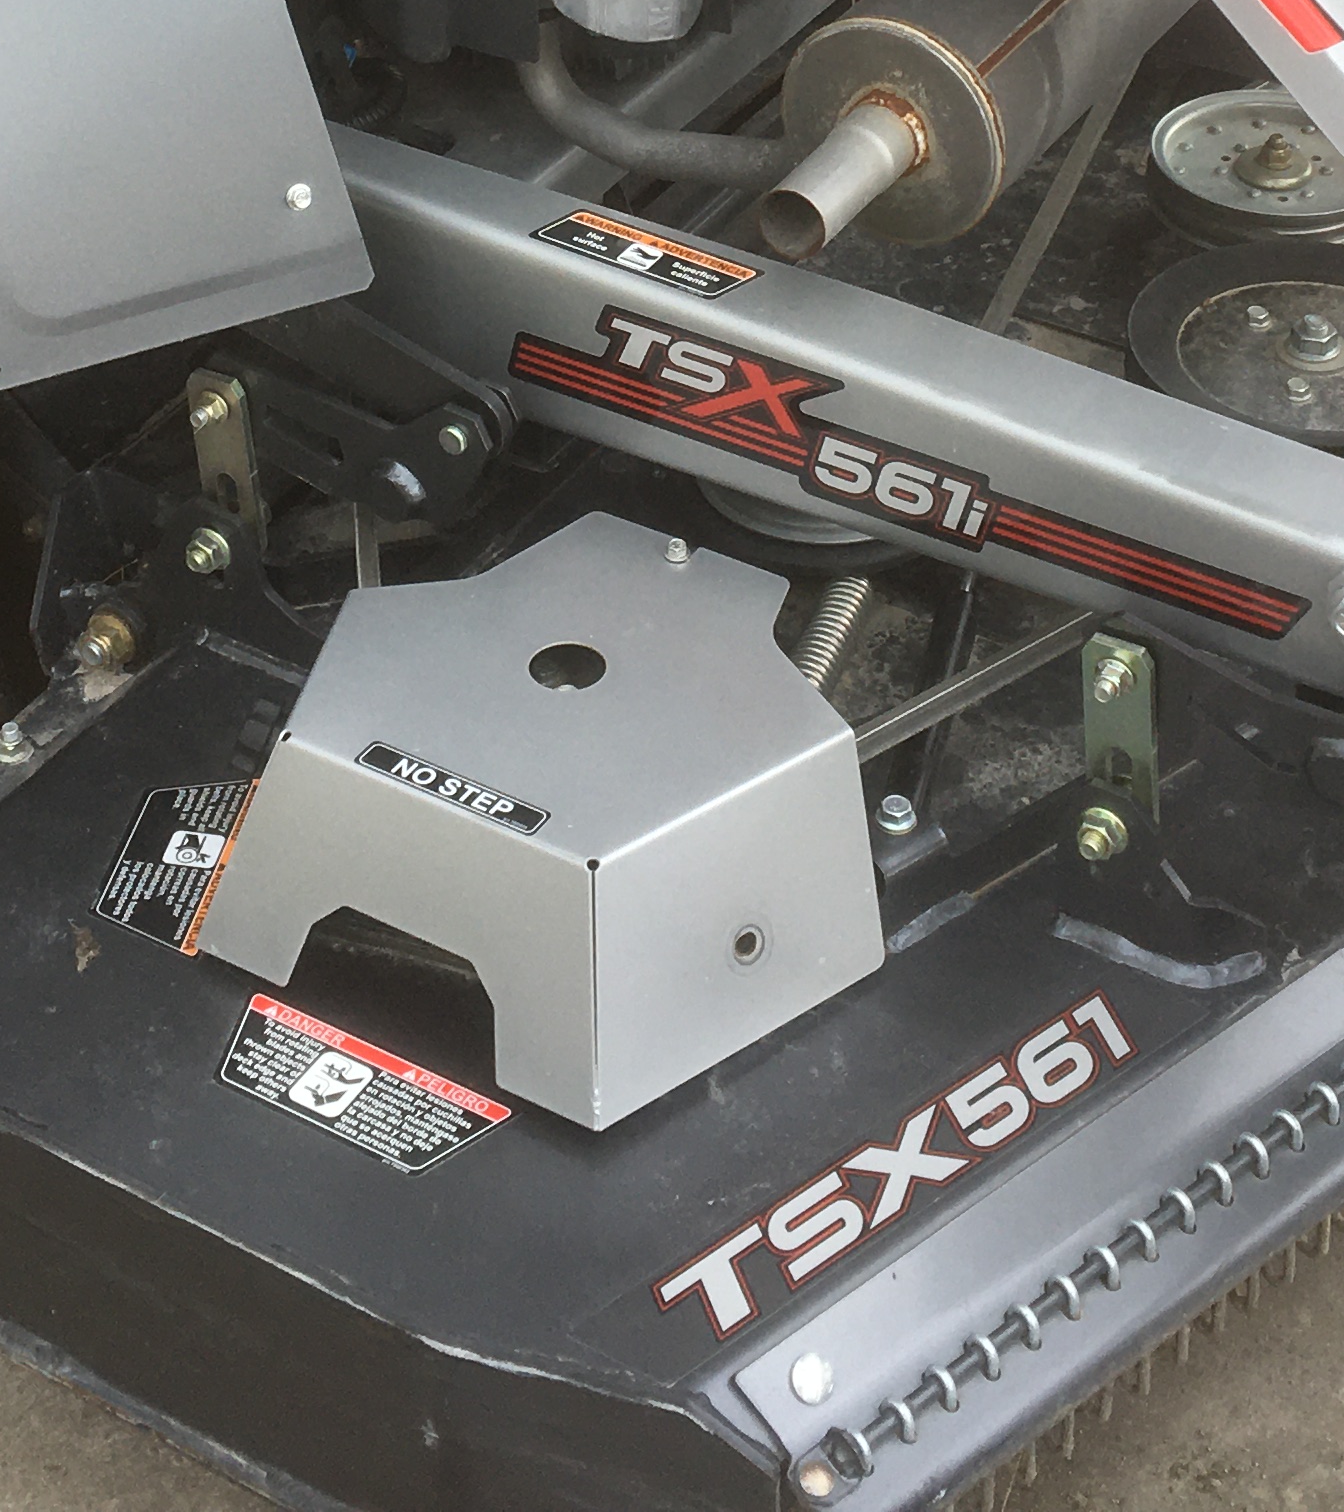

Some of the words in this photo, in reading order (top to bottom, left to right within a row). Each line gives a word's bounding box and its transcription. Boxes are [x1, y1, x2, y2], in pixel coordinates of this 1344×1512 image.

[572, 235, 608, 252] surface
[586, 216, 643, 241] WARNING
[586, 231, 605, 242] Hot
[662, 242, 748, 279] ADVERTENCIA
[670, 270, 709, 287] caliente
[672, 261, 720, 283] Superficie
[608, 316, 824, 439] TSX
[814, 435, 989, 539] 561i
[391, 758, 437, 785] NO
[438, 778, 515, 815] STEP
[279, 1008, 345, 1046] DANGER
[416, 1073, 490, 1112] PELIGRO
[656, 992, 1137, 1337] TSX561
